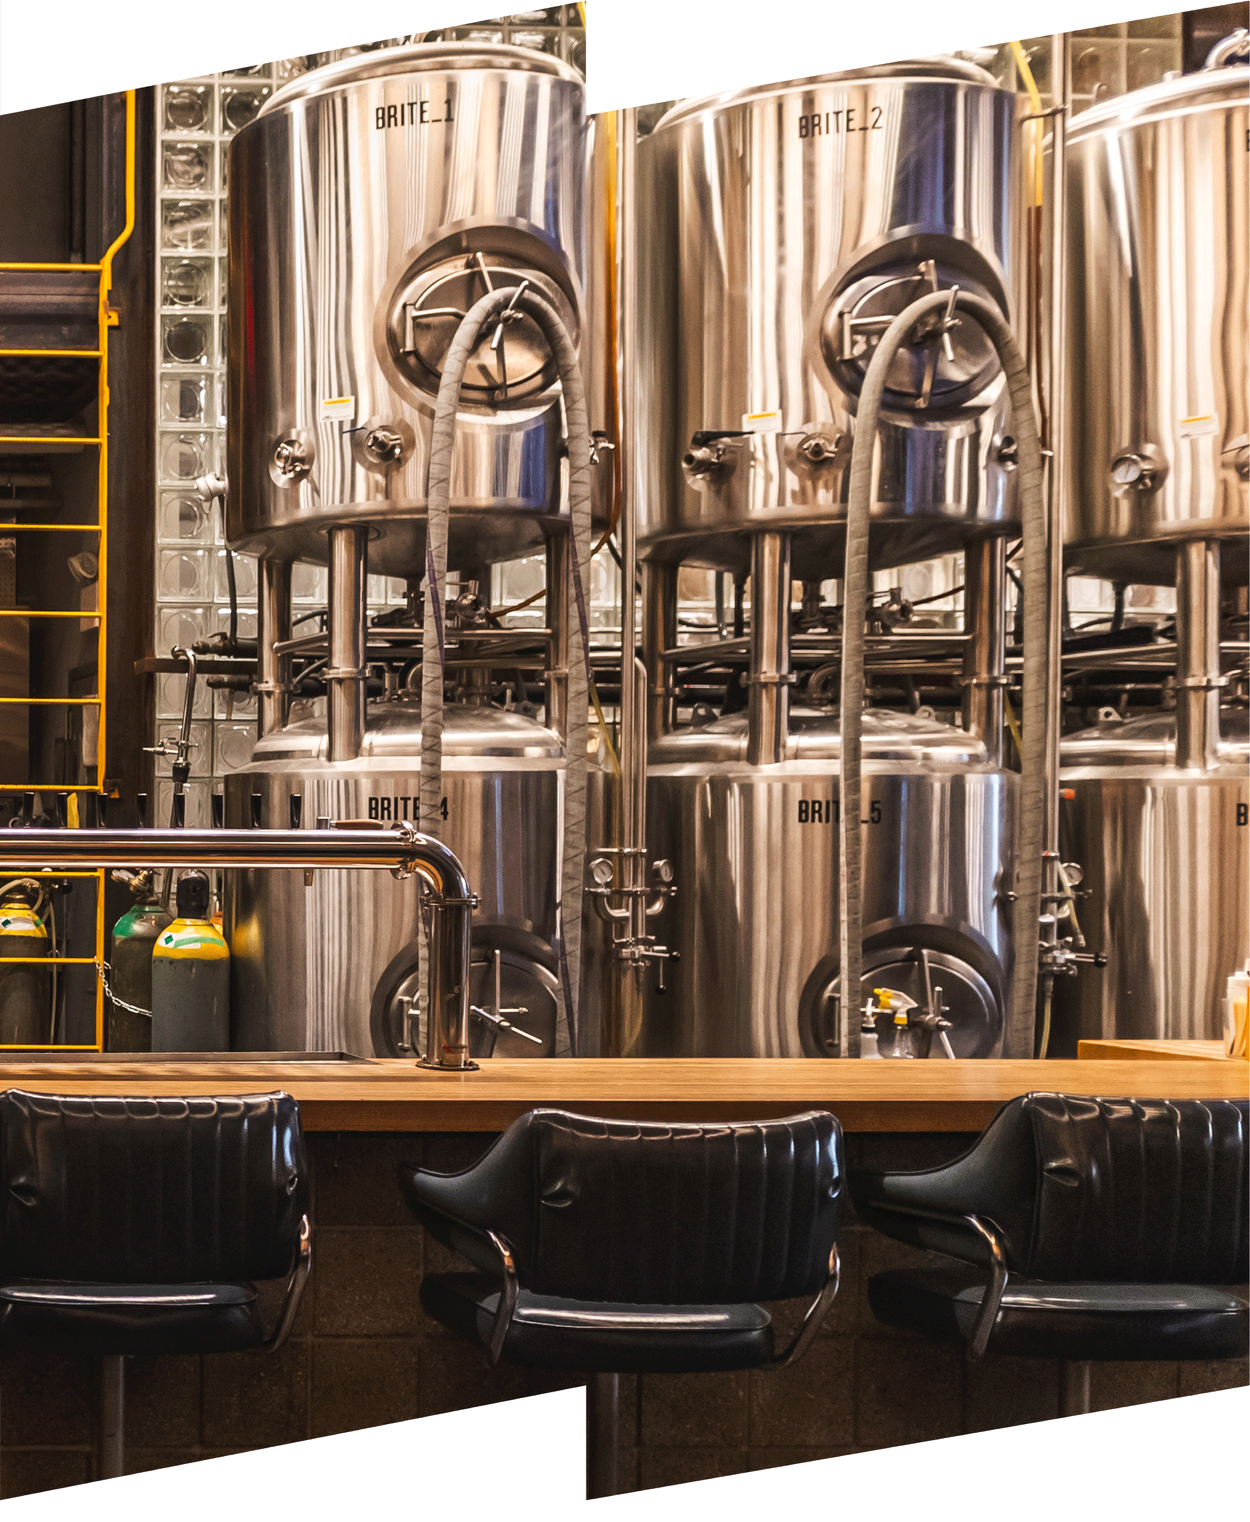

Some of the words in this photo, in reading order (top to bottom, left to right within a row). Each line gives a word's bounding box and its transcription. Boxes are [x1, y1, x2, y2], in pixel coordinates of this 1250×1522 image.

[375, 98, 454, 130] BRITE_1
[798, 106, 883, 138] BRITE_2
[798, 800, 882, 824] BRIT_5
